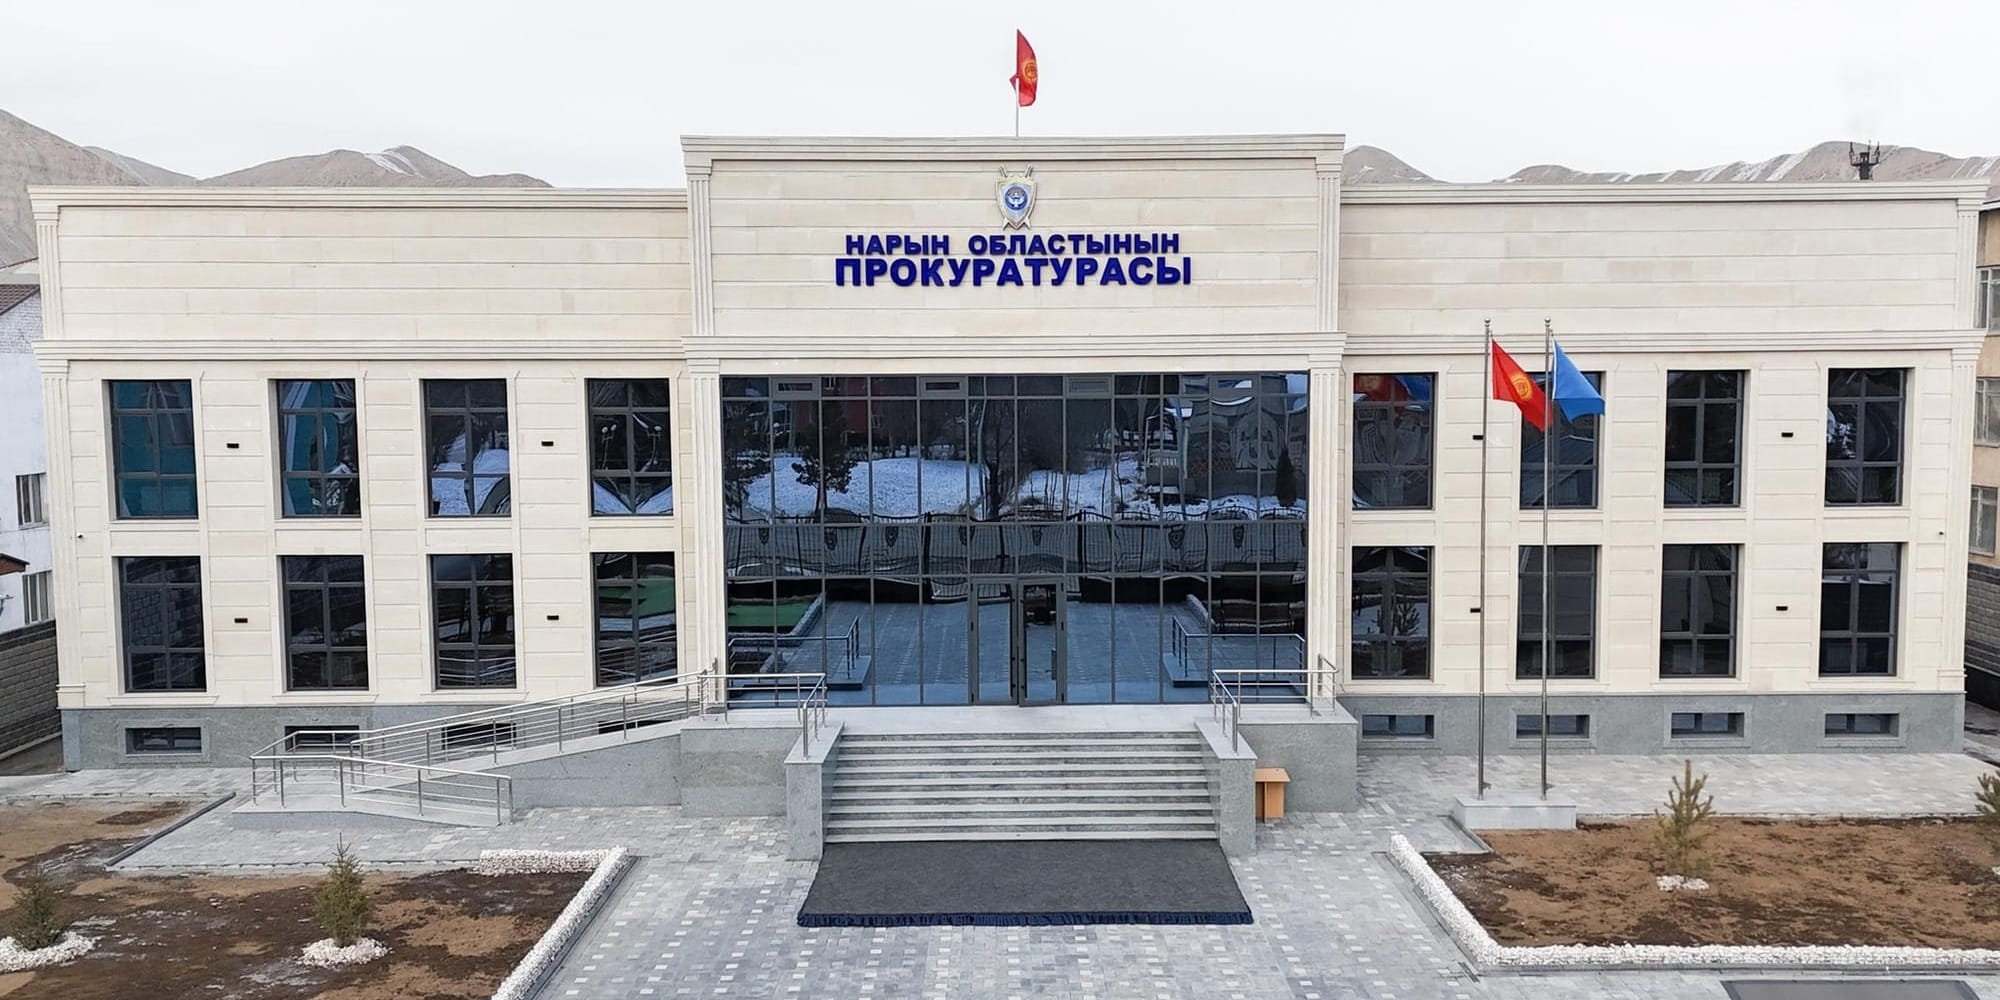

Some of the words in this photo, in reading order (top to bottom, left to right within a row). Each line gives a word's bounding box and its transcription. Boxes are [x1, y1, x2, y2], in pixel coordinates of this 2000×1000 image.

[845, 235, 950, 256] НАРЫН
[967, 233, 1180, 256] ОБЛАСТЫНЫН
[834, 256, 1192, 287] ПРОКУРАТУРАСЫ
